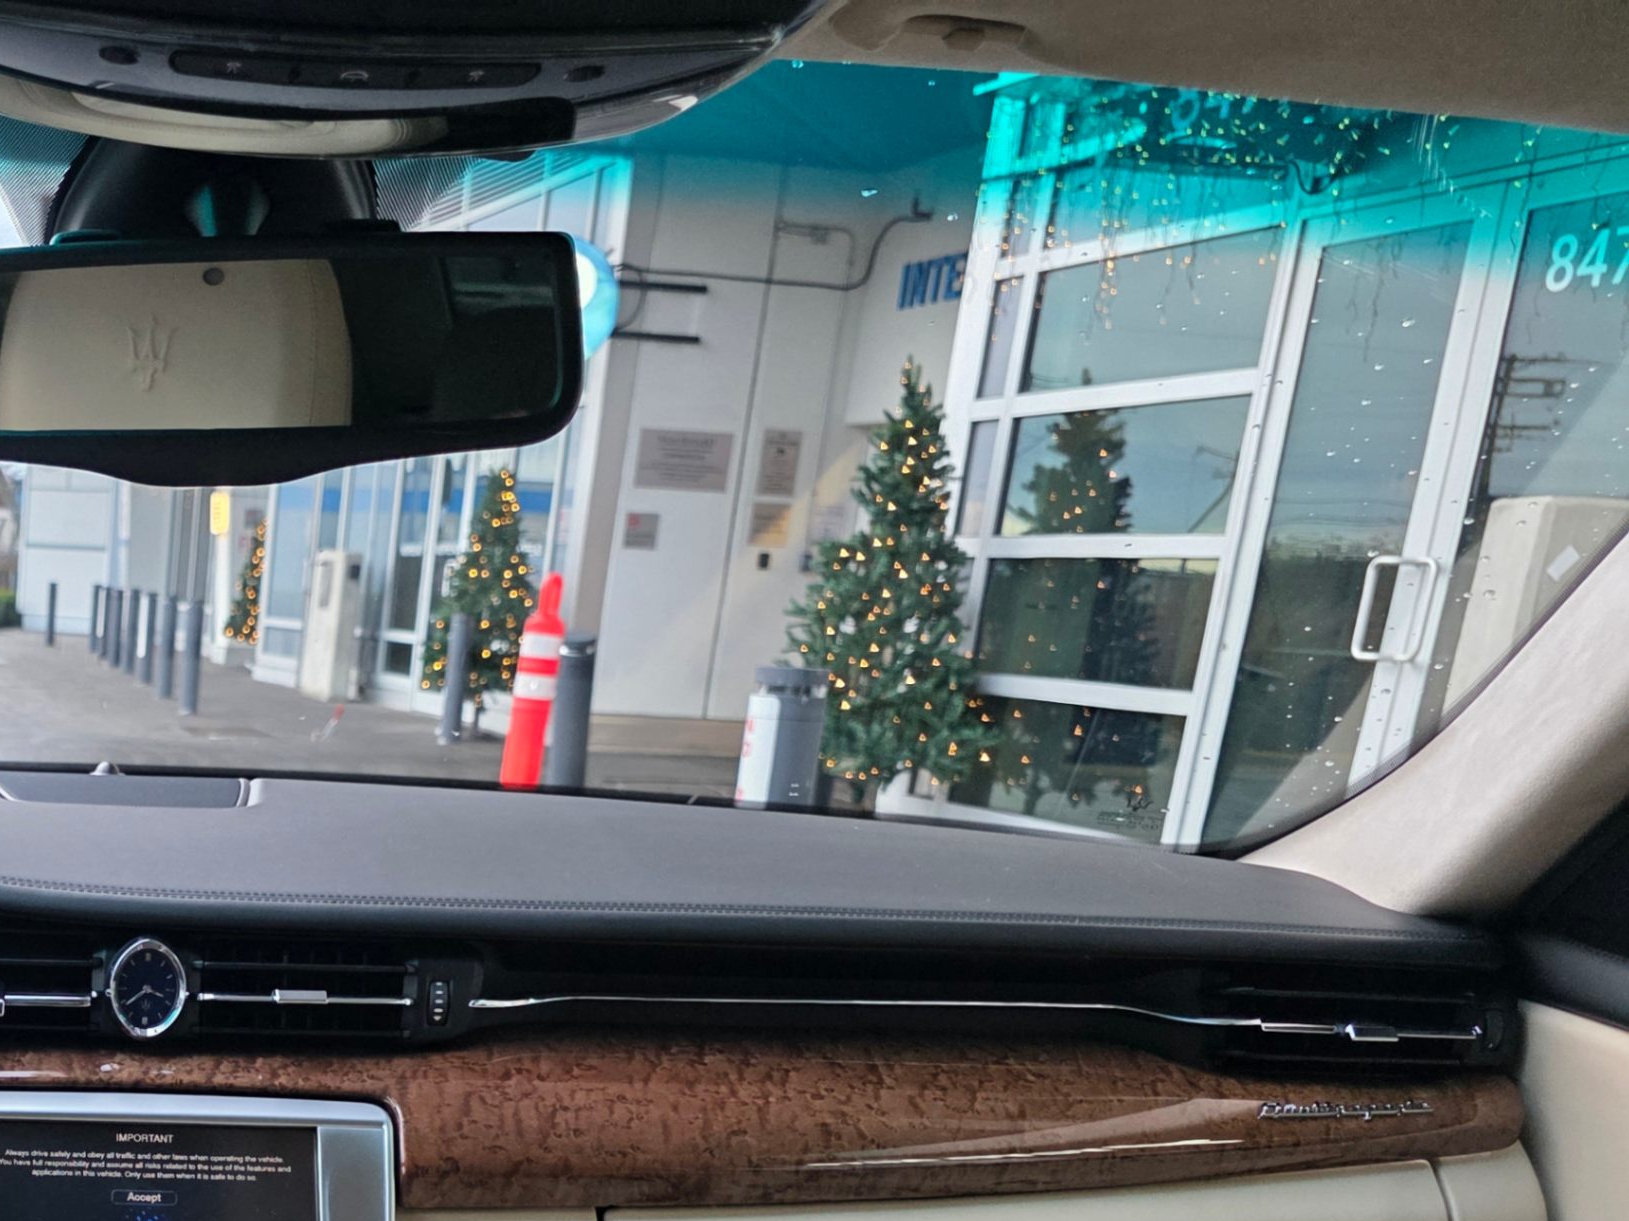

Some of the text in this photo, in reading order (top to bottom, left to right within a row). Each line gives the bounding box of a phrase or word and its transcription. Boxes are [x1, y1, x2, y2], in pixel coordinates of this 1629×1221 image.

[116, 1133, 174, 1144] IMPORTANT
[5, 1149, 30, 1158] Always
[31, 1150, 48, 1158] drive
[50, 1151, 70, 1159] safely
[88, 1152, 105, 1160] obey
[210, 1155, 244, 1163] operating
[14, 1158, 30, 1166] have
[44, 1160, 90, 1168] responsibility
[144, 1162, 162, 1170] risks
[32, 1168, 73, 1177] applications
[96, 1170, 122, 1178] vehicle.
[124, 1171, 142, 1180] Only
[176, 1172, 196, 1180] when
[126, 1192, 162, 1204] Accept
